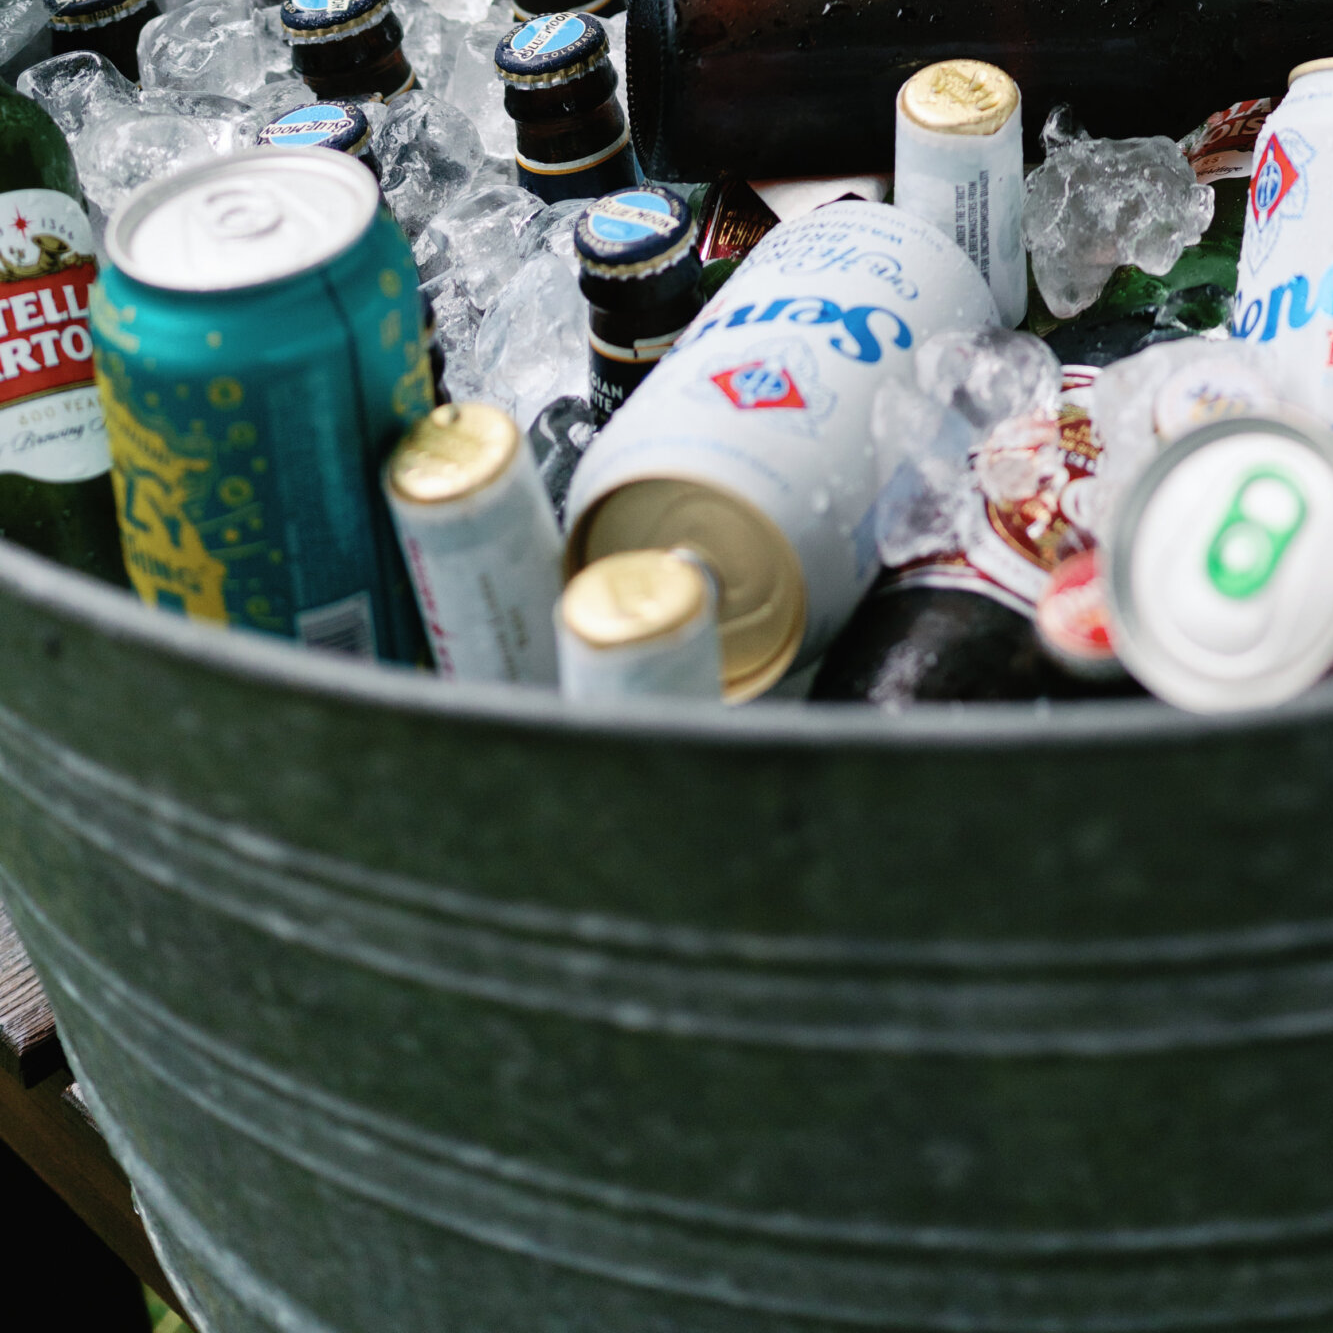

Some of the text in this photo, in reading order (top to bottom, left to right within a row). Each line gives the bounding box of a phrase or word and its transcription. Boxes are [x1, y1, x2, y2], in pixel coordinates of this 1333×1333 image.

[519, 12, 573, 60] BLUE MOON
[541, 26, 598, 61] COLORADO
[262, 120, 353, 136] BLUE MOON
[0, 283, 96, 337] TELL
[690, 295, 913, 365] Sen
[0, 324, 93, 381] RTO
[63, 394, 103, 416] YEA
